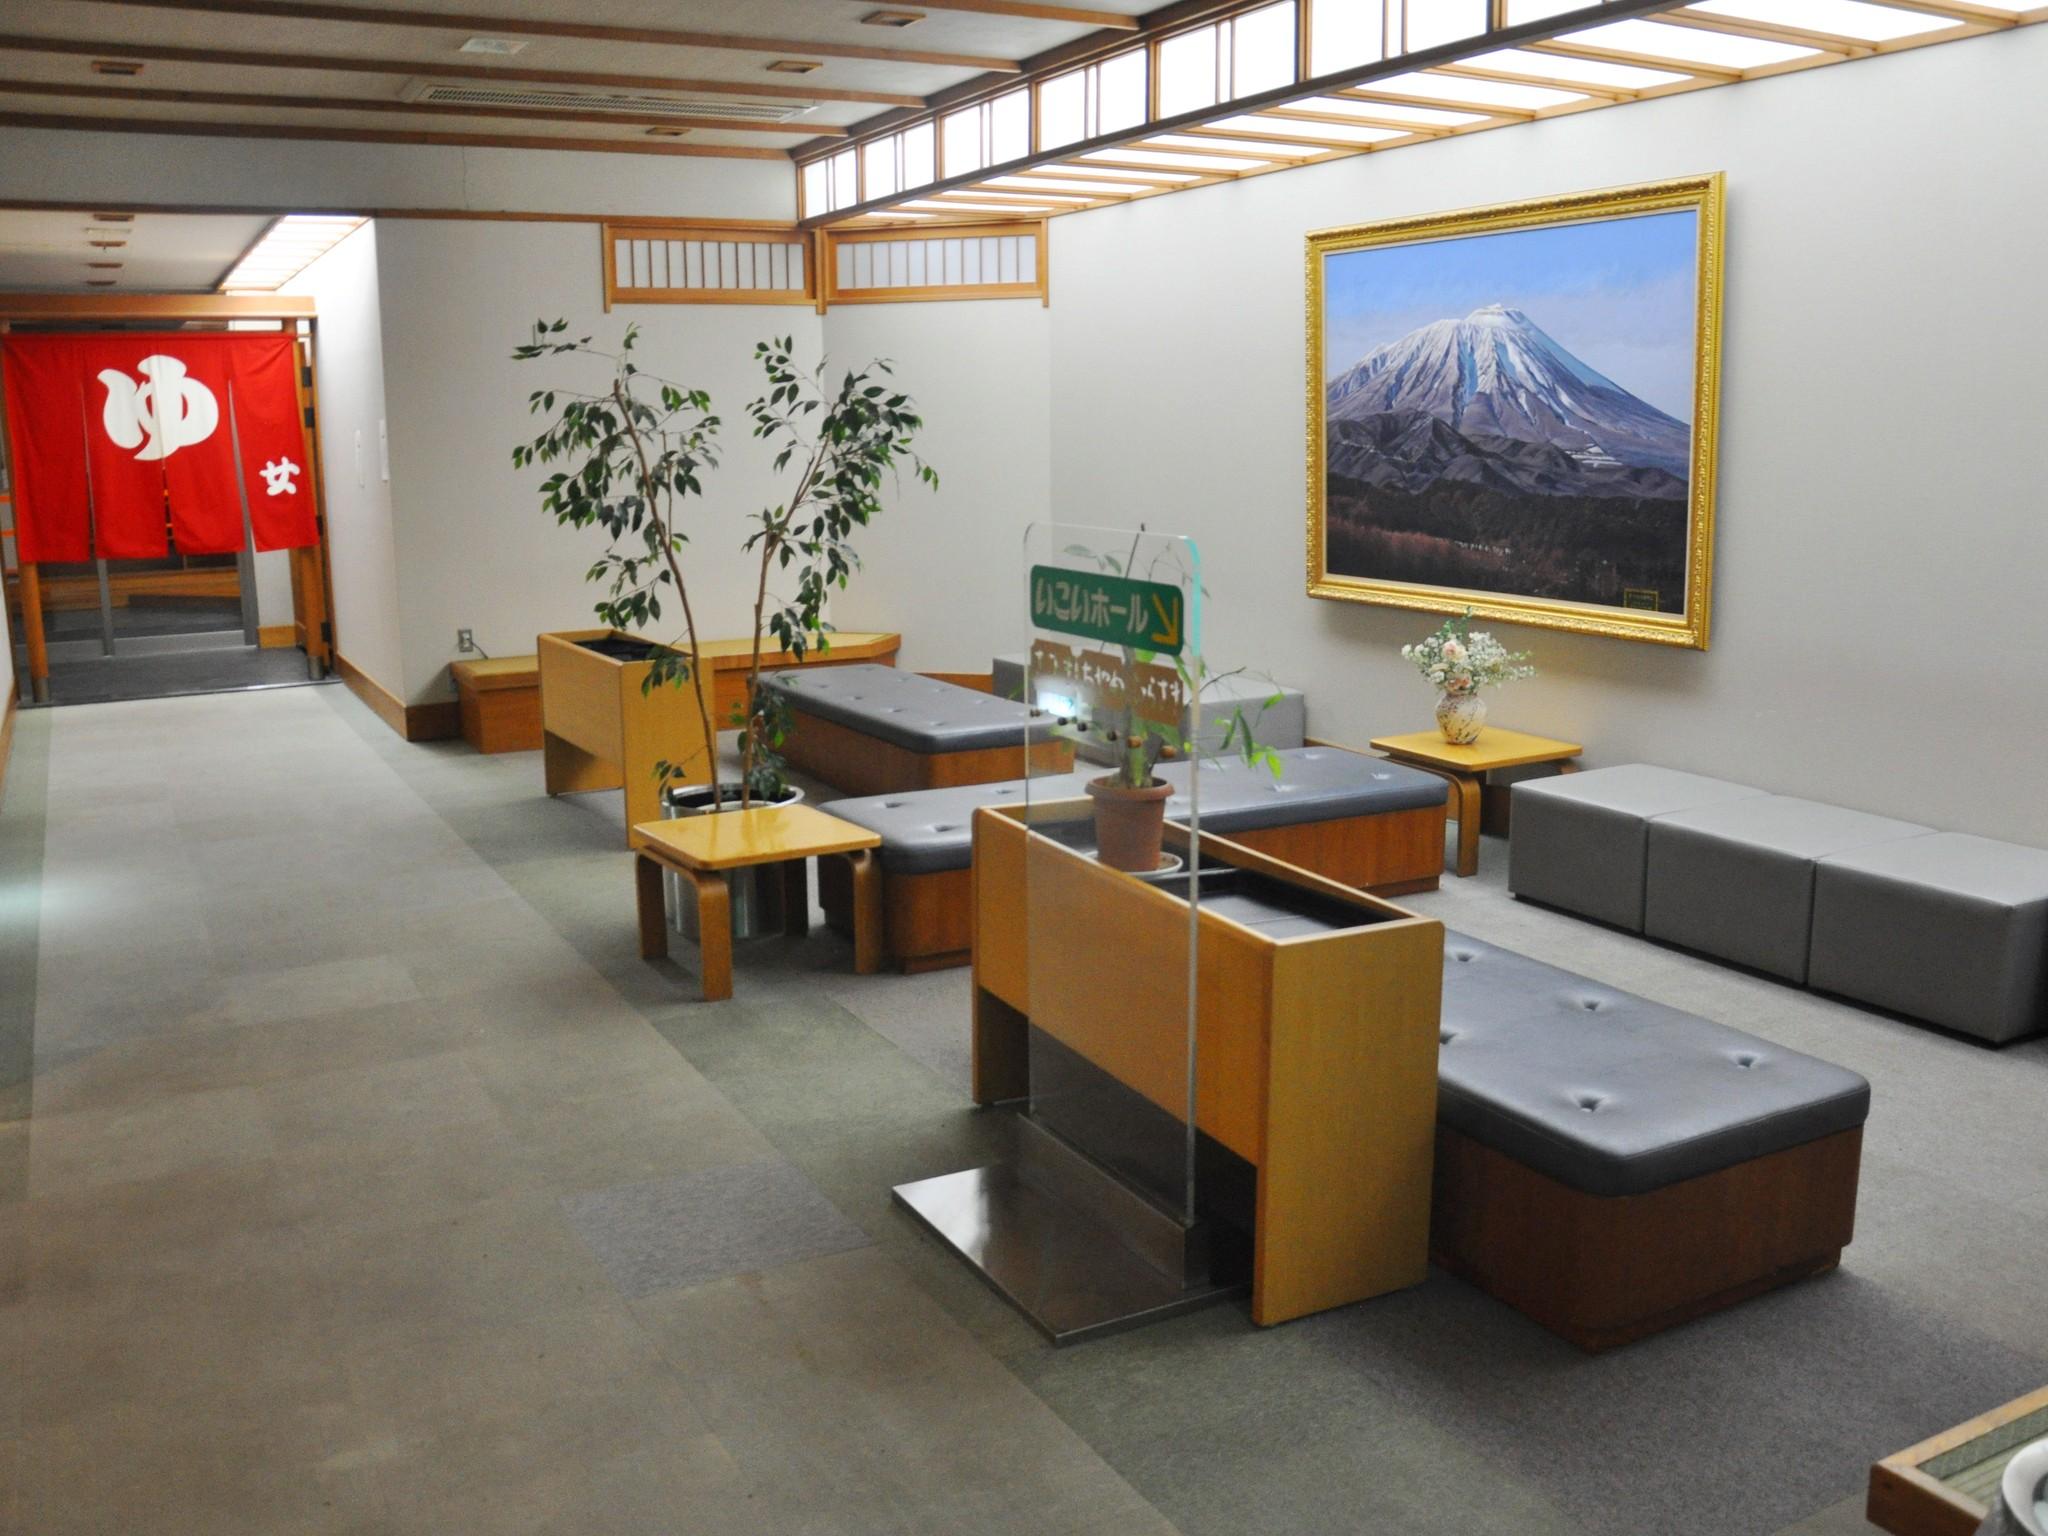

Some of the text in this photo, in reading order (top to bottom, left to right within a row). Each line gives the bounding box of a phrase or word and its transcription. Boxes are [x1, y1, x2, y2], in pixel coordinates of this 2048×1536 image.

[98, 355, 219, 461] ゆ
[259, 456, 301, 496] 女
[1034, 577, 1149, 634] いこいホール
